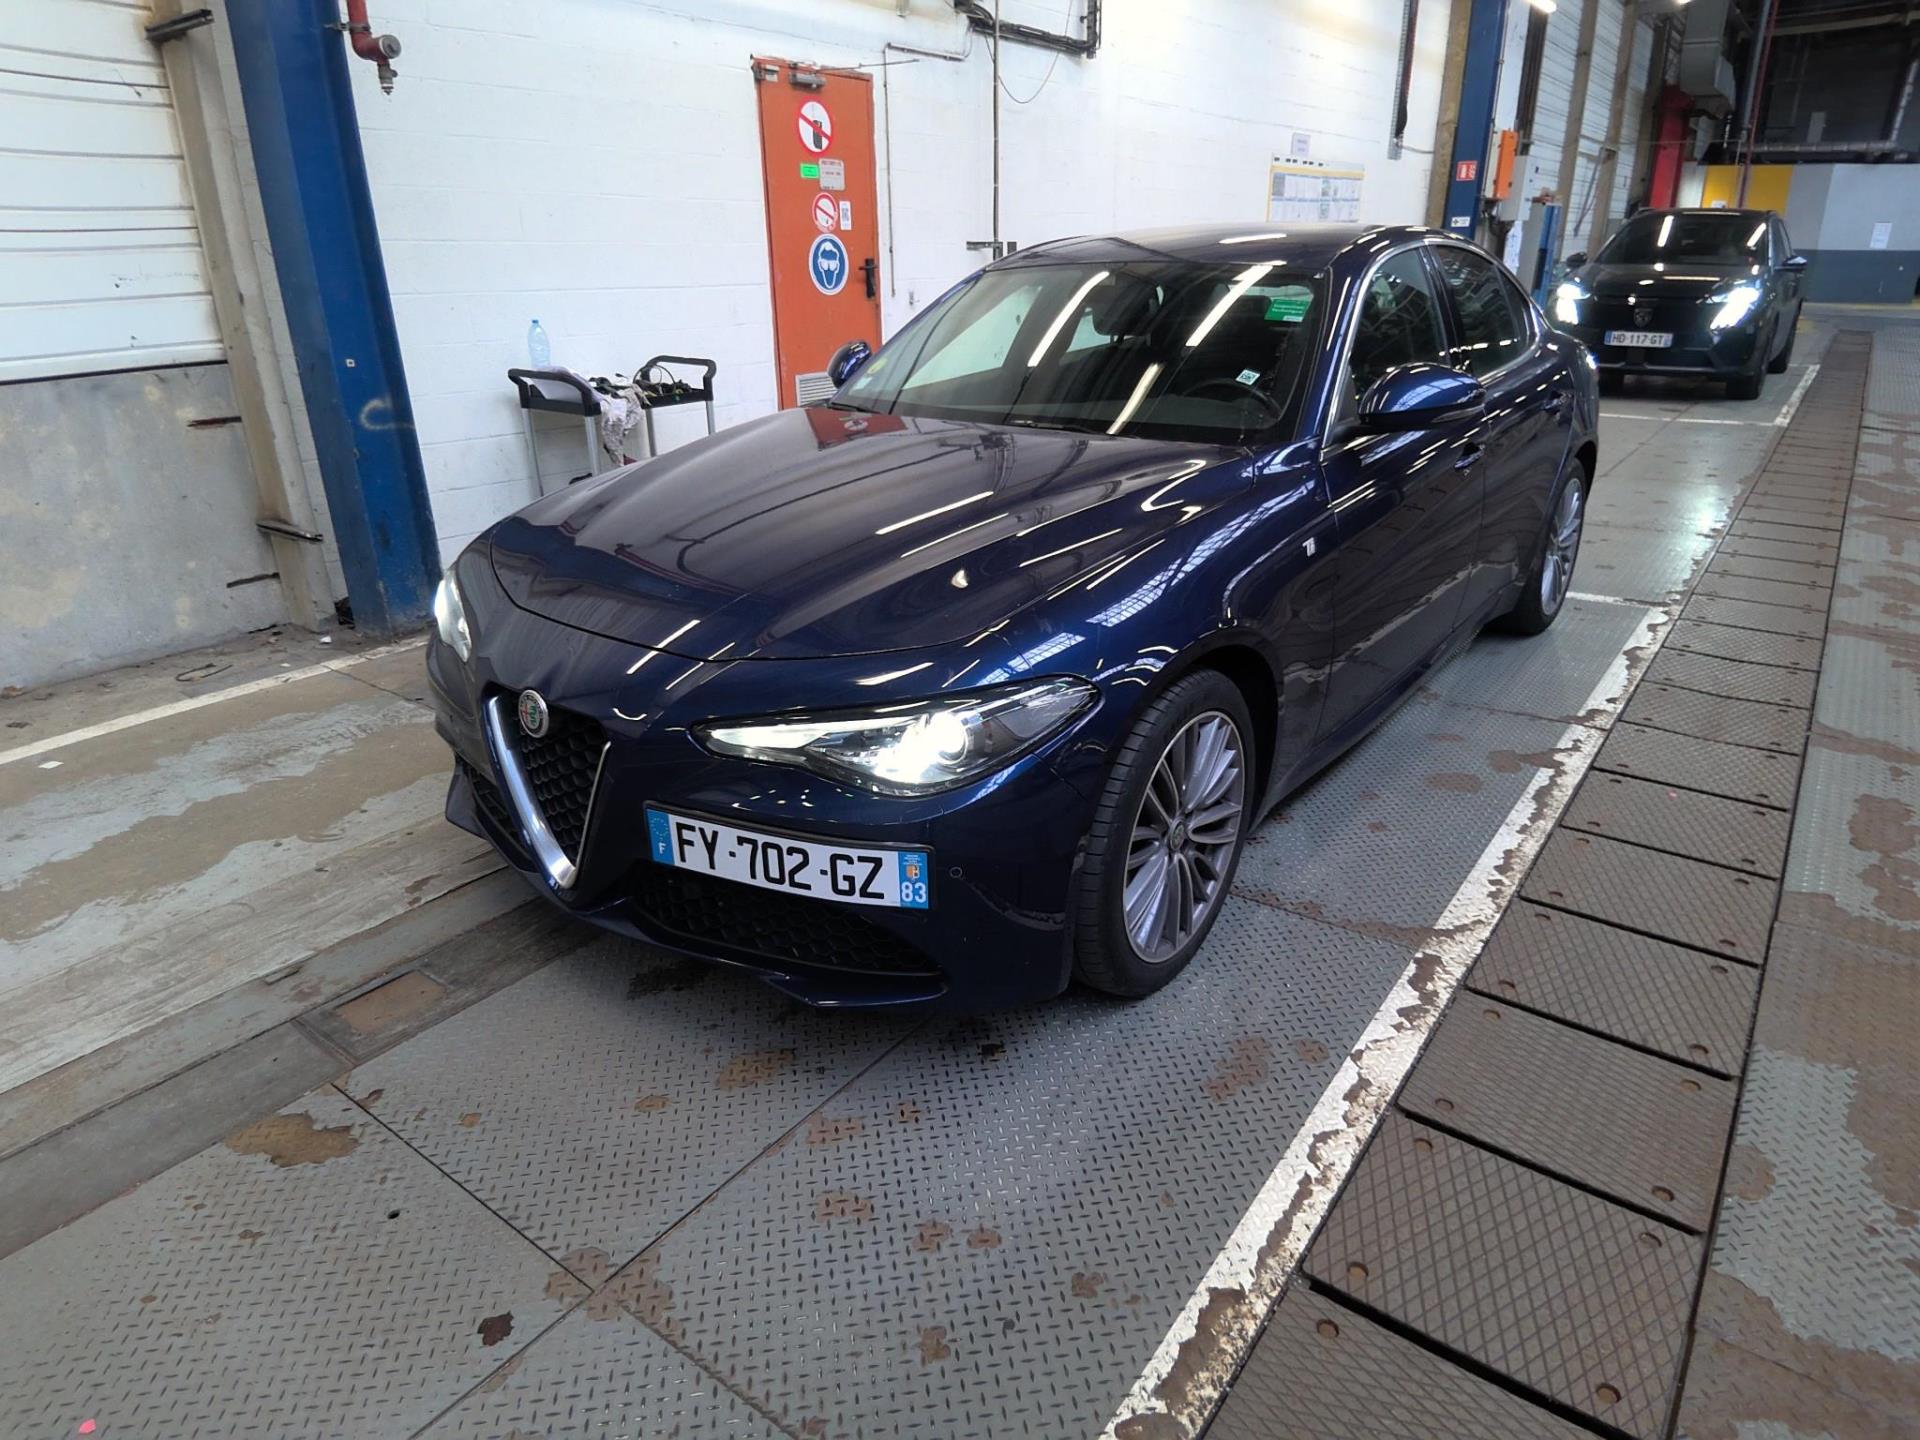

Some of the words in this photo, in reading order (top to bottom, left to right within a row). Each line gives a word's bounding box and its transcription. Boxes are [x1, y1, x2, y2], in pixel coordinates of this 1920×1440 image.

[658, 842, 667, 854] F
[675, 821, 885, 900] FY-702-GZ
[901, 881, 927, 903] 83
